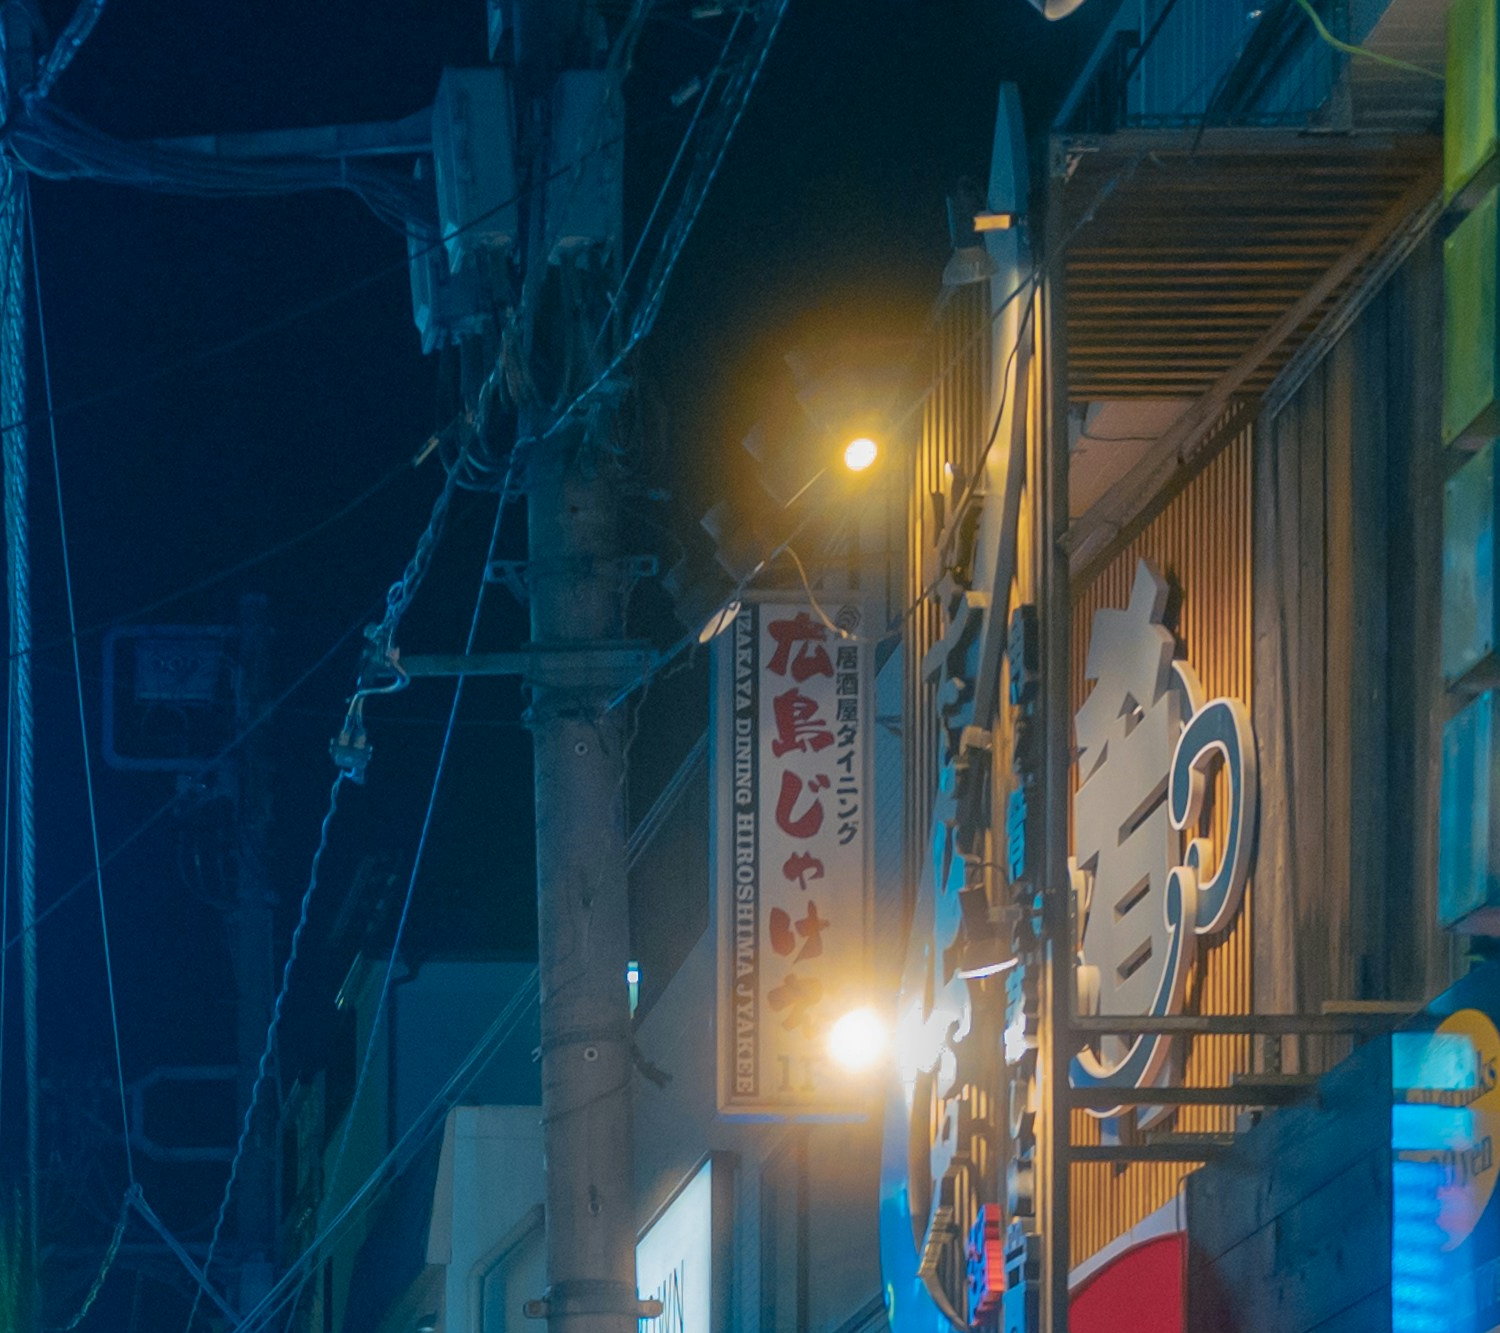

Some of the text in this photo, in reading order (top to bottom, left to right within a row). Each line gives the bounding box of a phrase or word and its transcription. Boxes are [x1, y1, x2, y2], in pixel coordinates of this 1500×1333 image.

[735, 606, 756, 1094] IZAKAYA DINING HIROSHIMA JYAKEE
[835, 646, 860, 846] 居酒屋ダイニング
